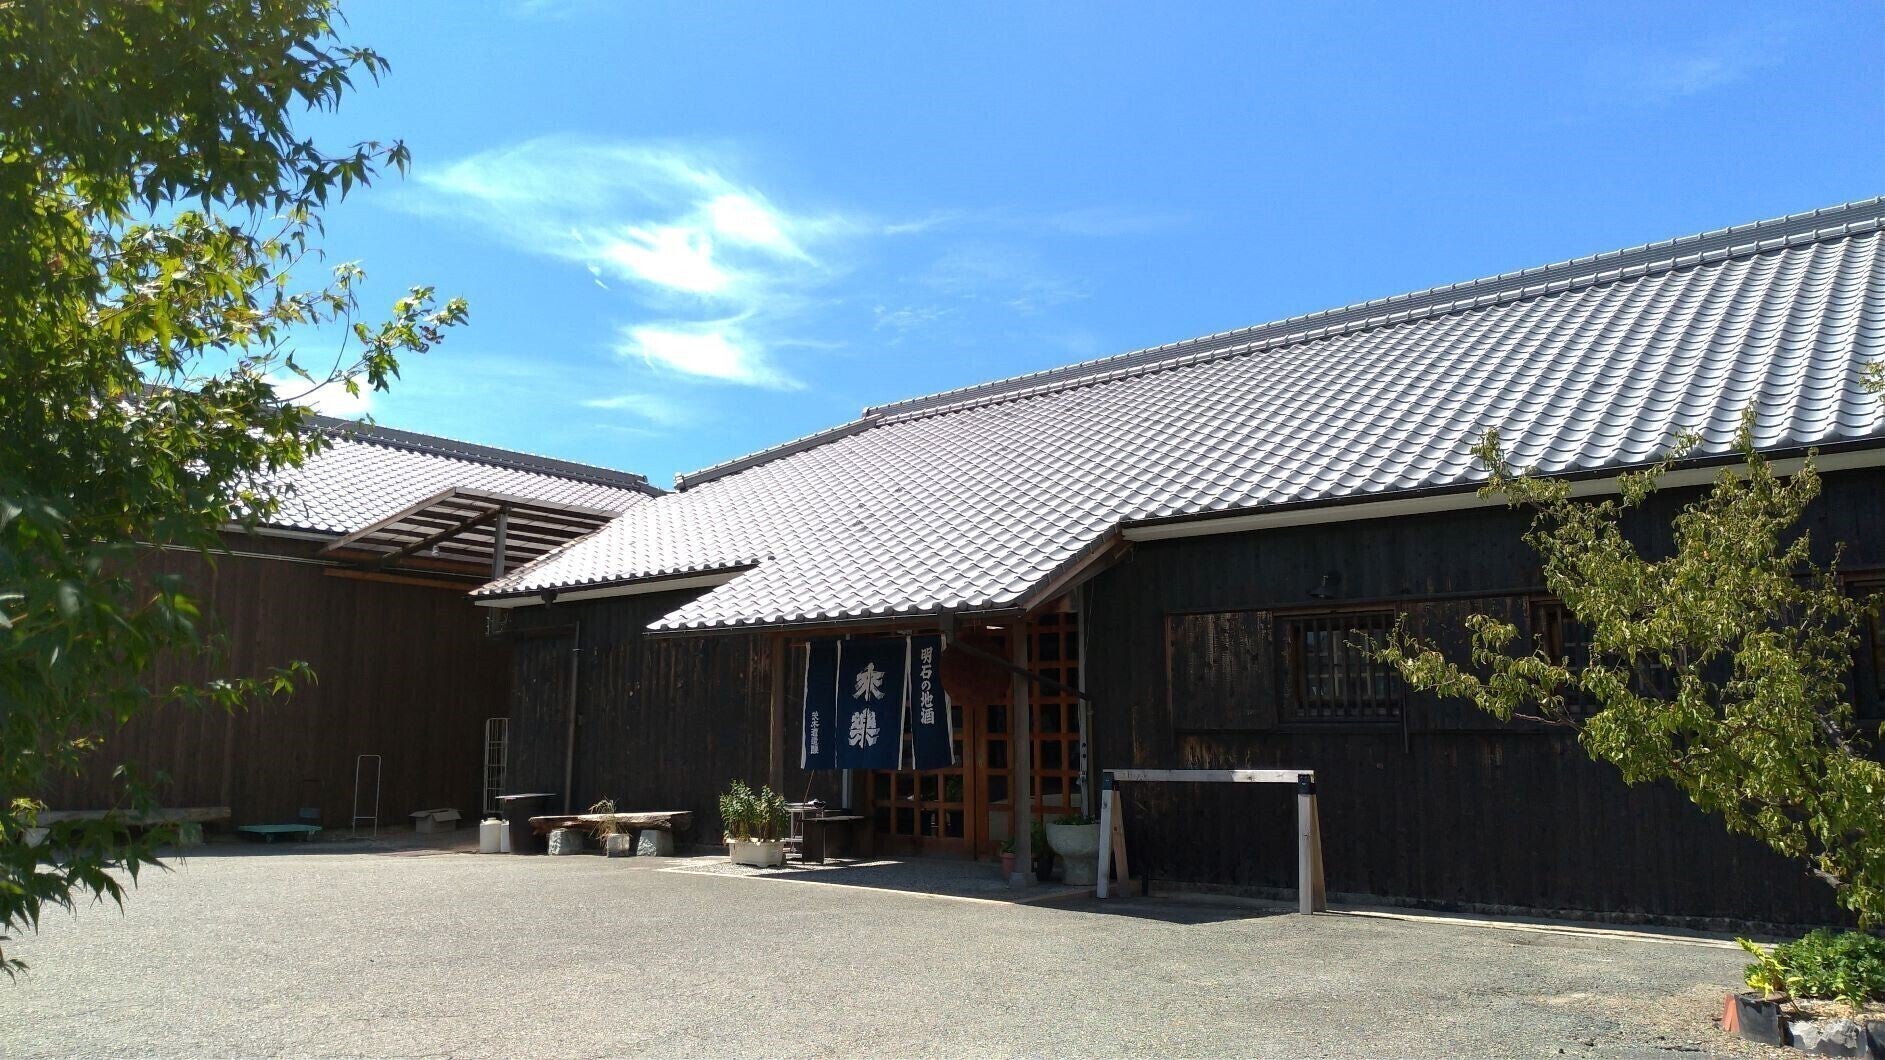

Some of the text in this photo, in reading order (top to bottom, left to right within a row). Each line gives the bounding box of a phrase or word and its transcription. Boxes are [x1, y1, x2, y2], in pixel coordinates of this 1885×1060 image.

[919, 646, 935, 725] 明石の地酒
